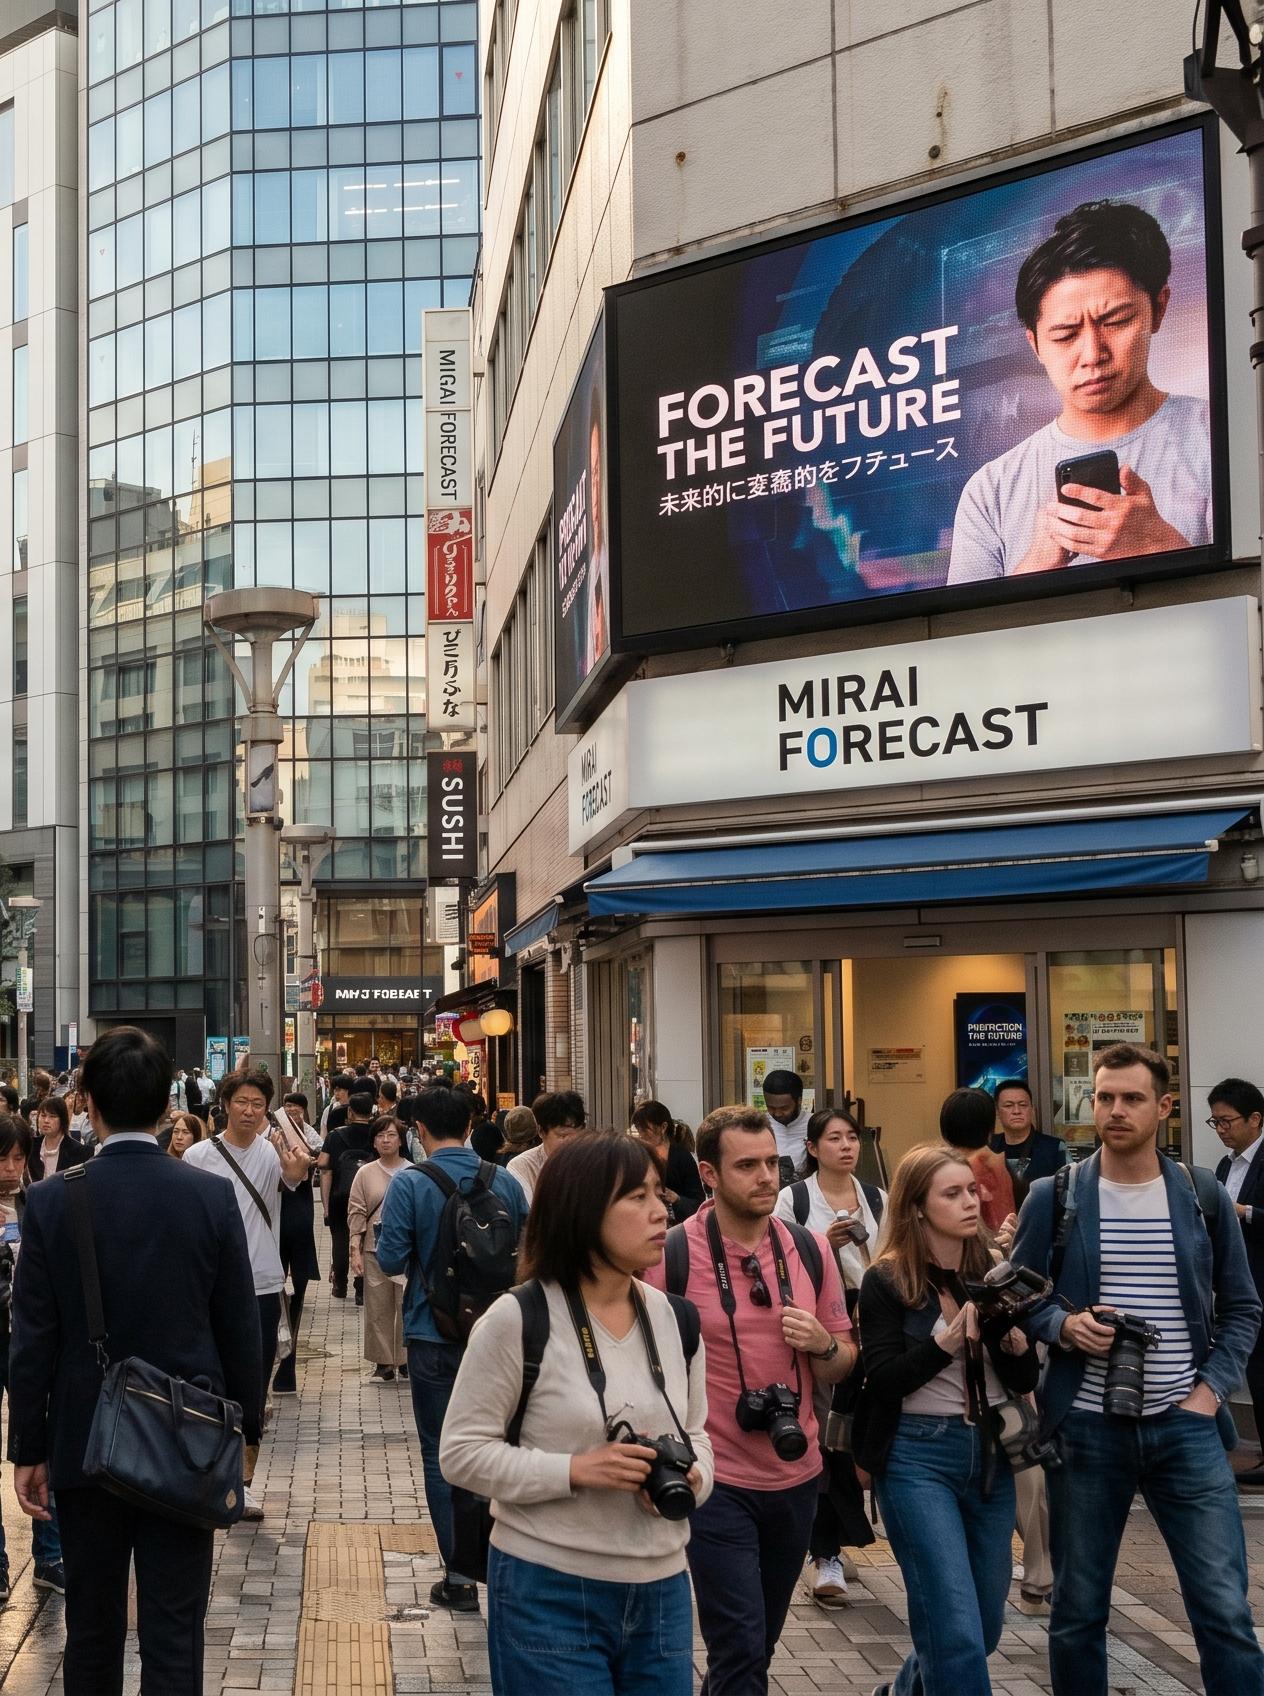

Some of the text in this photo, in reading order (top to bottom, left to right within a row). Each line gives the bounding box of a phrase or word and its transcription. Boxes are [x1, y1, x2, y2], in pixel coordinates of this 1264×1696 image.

[439, 349, 457, 500] MIGAI FORECAST
[658, 325, 959, 439] FORECAST
[657, 379, 961, 481] THE FUTURE
[778, 666, 918, 722] MIRAI
[779, 702, 1048, 771] FORECAST
[442, 777, 464, 859] SUSHI
